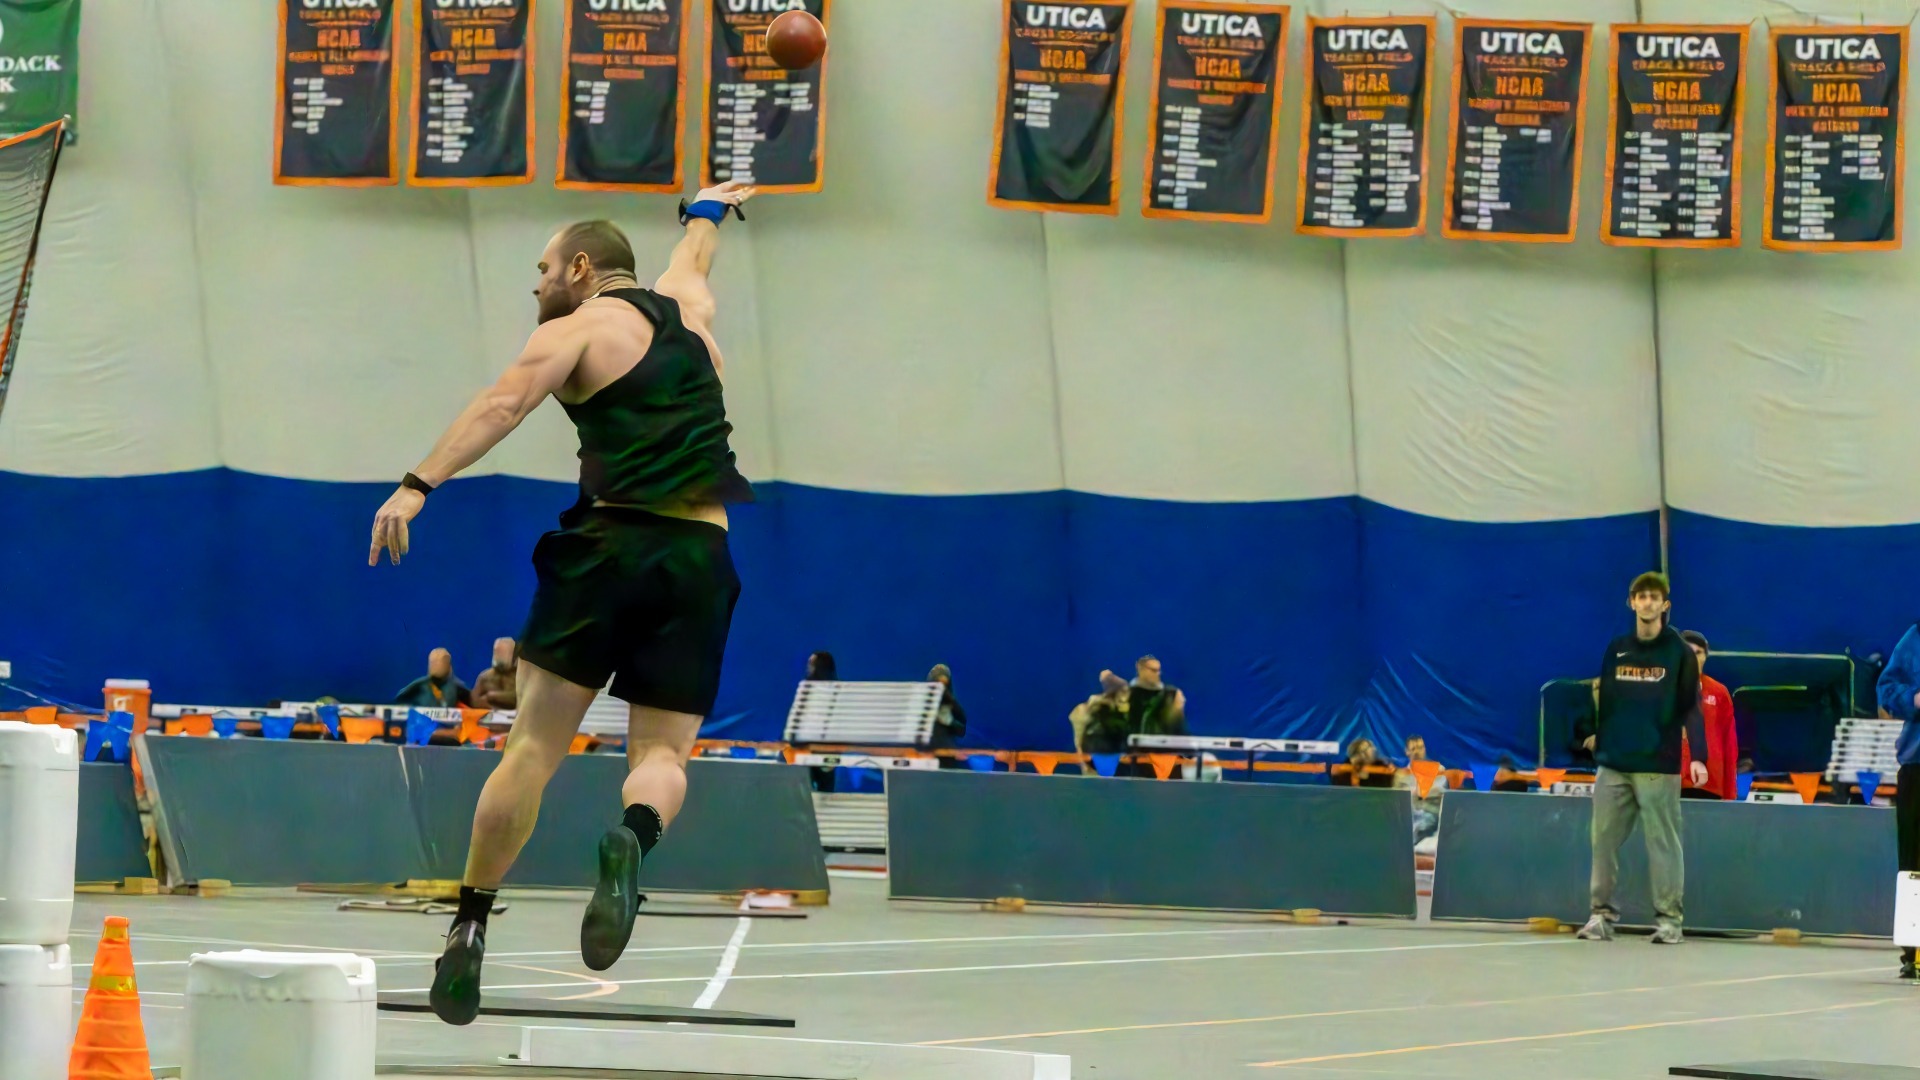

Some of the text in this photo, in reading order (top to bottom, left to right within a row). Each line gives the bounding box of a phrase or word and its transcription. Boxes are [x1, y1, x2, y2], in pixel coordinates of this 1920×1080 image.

[1026, 4, 1106, 29] UTICA
[1181, 12, 1263, 37] UTICA
[1327, 28, 1409, 50] UTICA
[1480, 31, 1565, 55] UTICA
[1636, 35, 1721, 59] UTICA
[1795, 37, 1882, 60] UTICA
[1342, 71, 1391, 93] NCAA
[1495, 75, 1544, 97] NCAA
[1652, 81, 1701, 101] NCAA
[1812, 82, 1862, 103] NCAA
